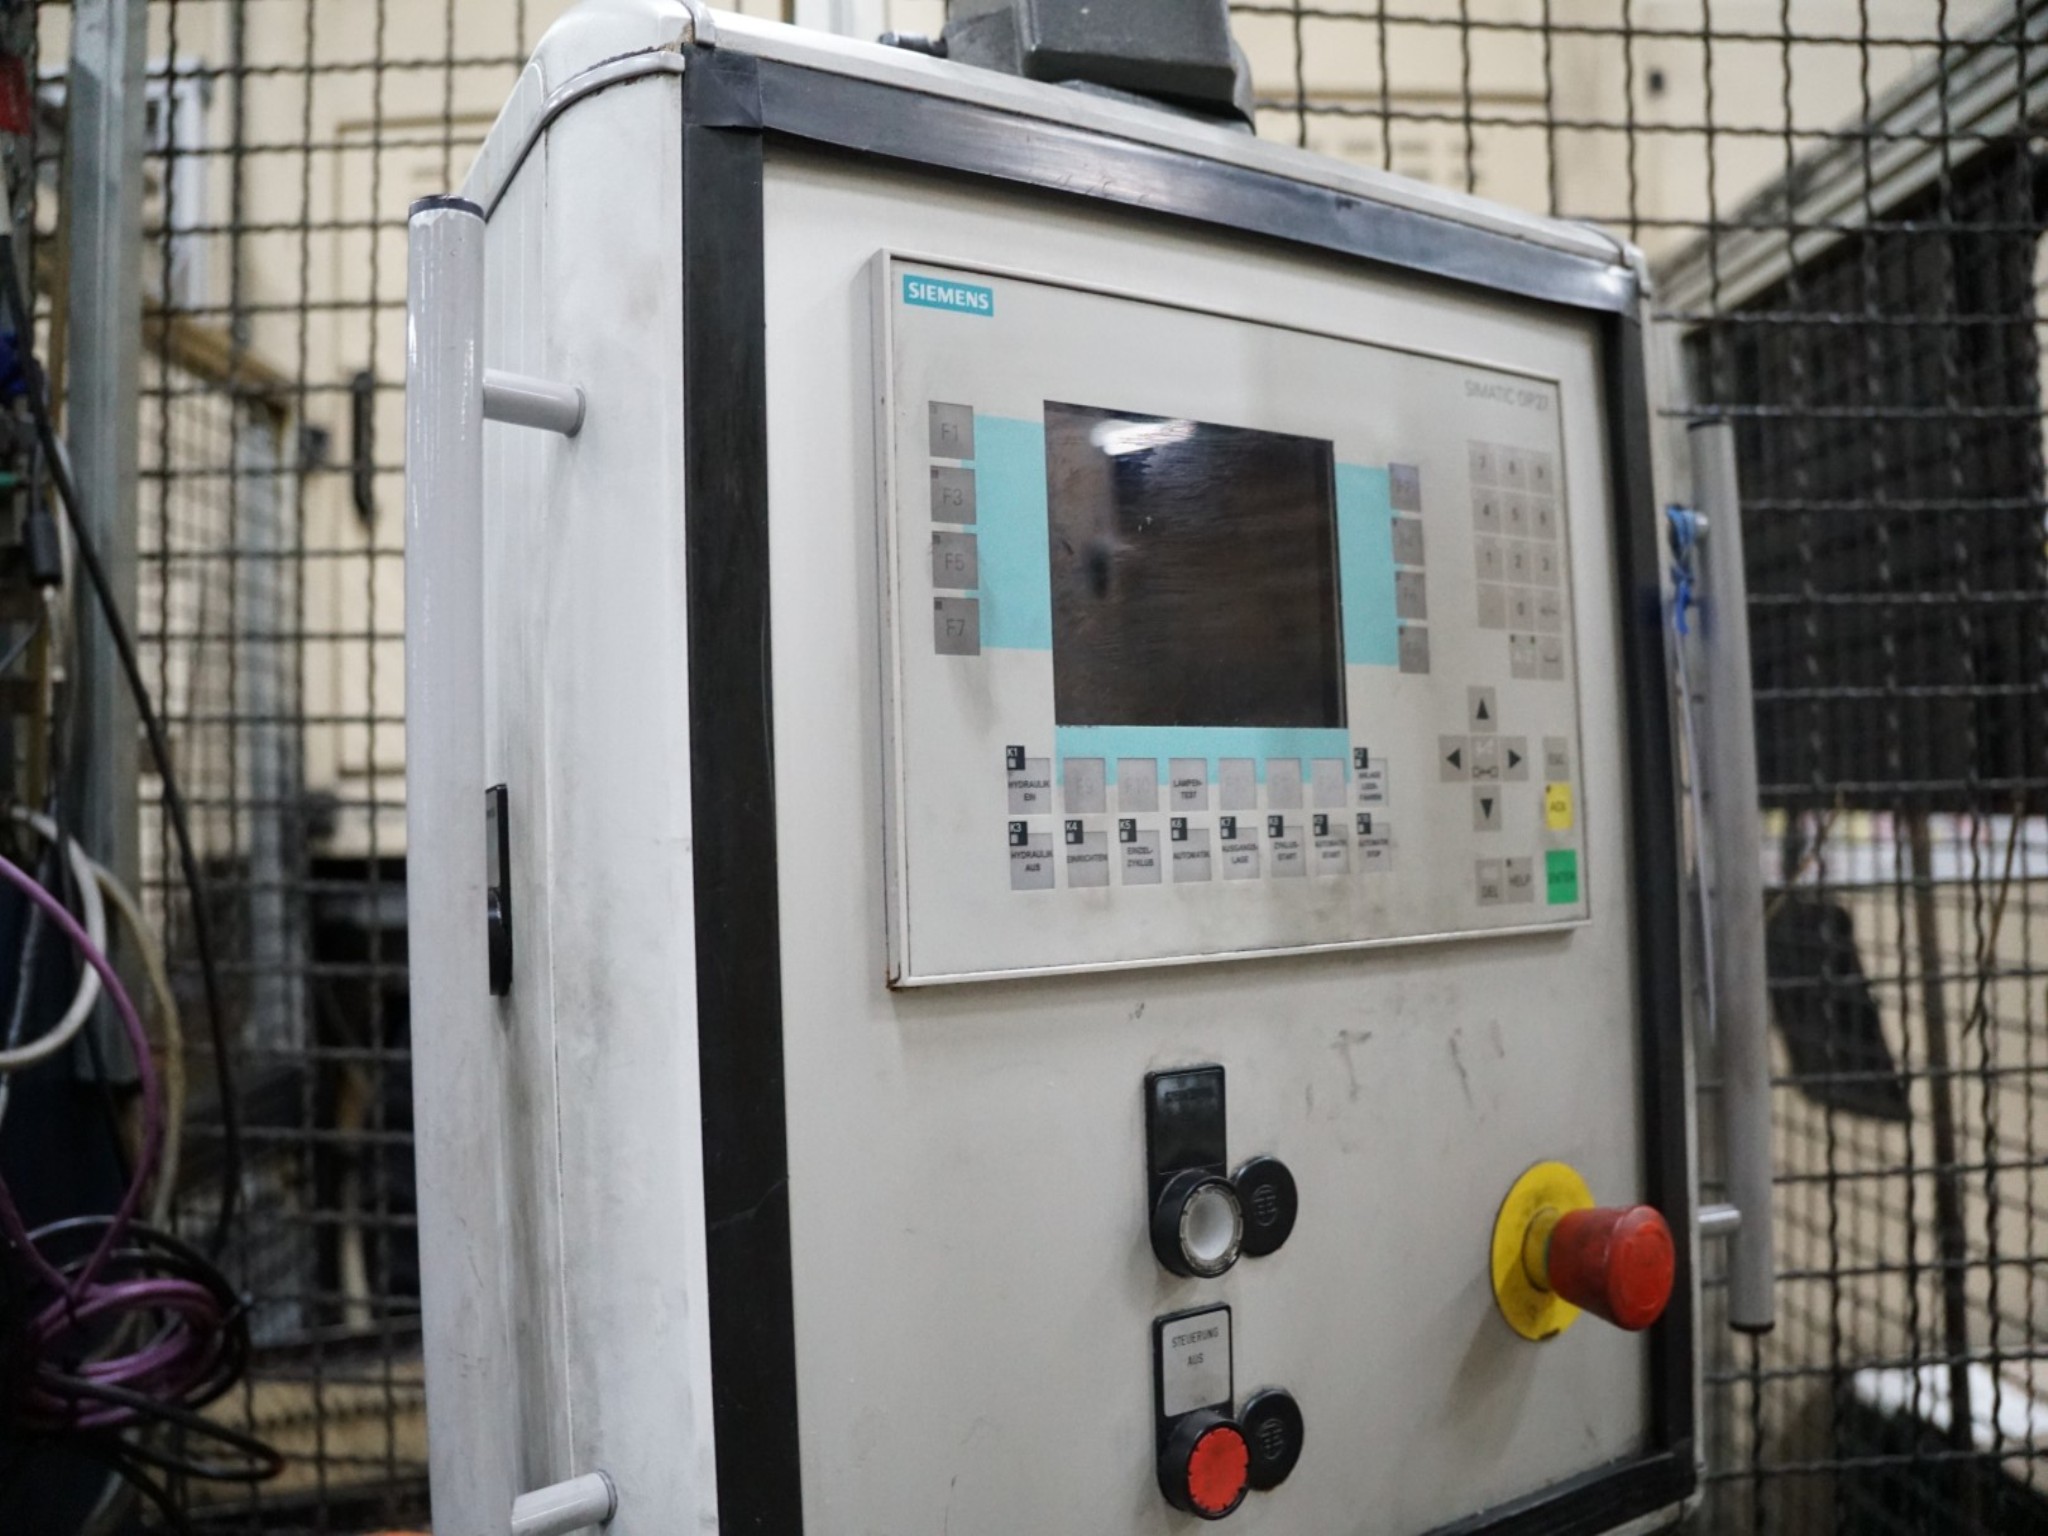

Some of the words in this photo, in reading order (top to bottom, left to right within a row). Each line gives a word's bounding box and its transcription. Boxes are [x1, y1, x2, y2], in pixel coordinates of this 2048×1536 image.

[907, 281, 990, 310] SIEMENS
[940, 422, 960, 442] F1
[943, 487, 963, 507] F3
[945, 552, 966, 572] F5
[945, 617, 966, 637] F7
[1010, 822, 1021, 833] K3
[1066, 821, 1078, 831] K4
[1120, 820, 1131, 830] K5
[1026, 864, 1041, 872] AUS
[1172, 1327, 1219, 1348] STEUERUNG
[1188, 1353, 1204, 1367] AUS
